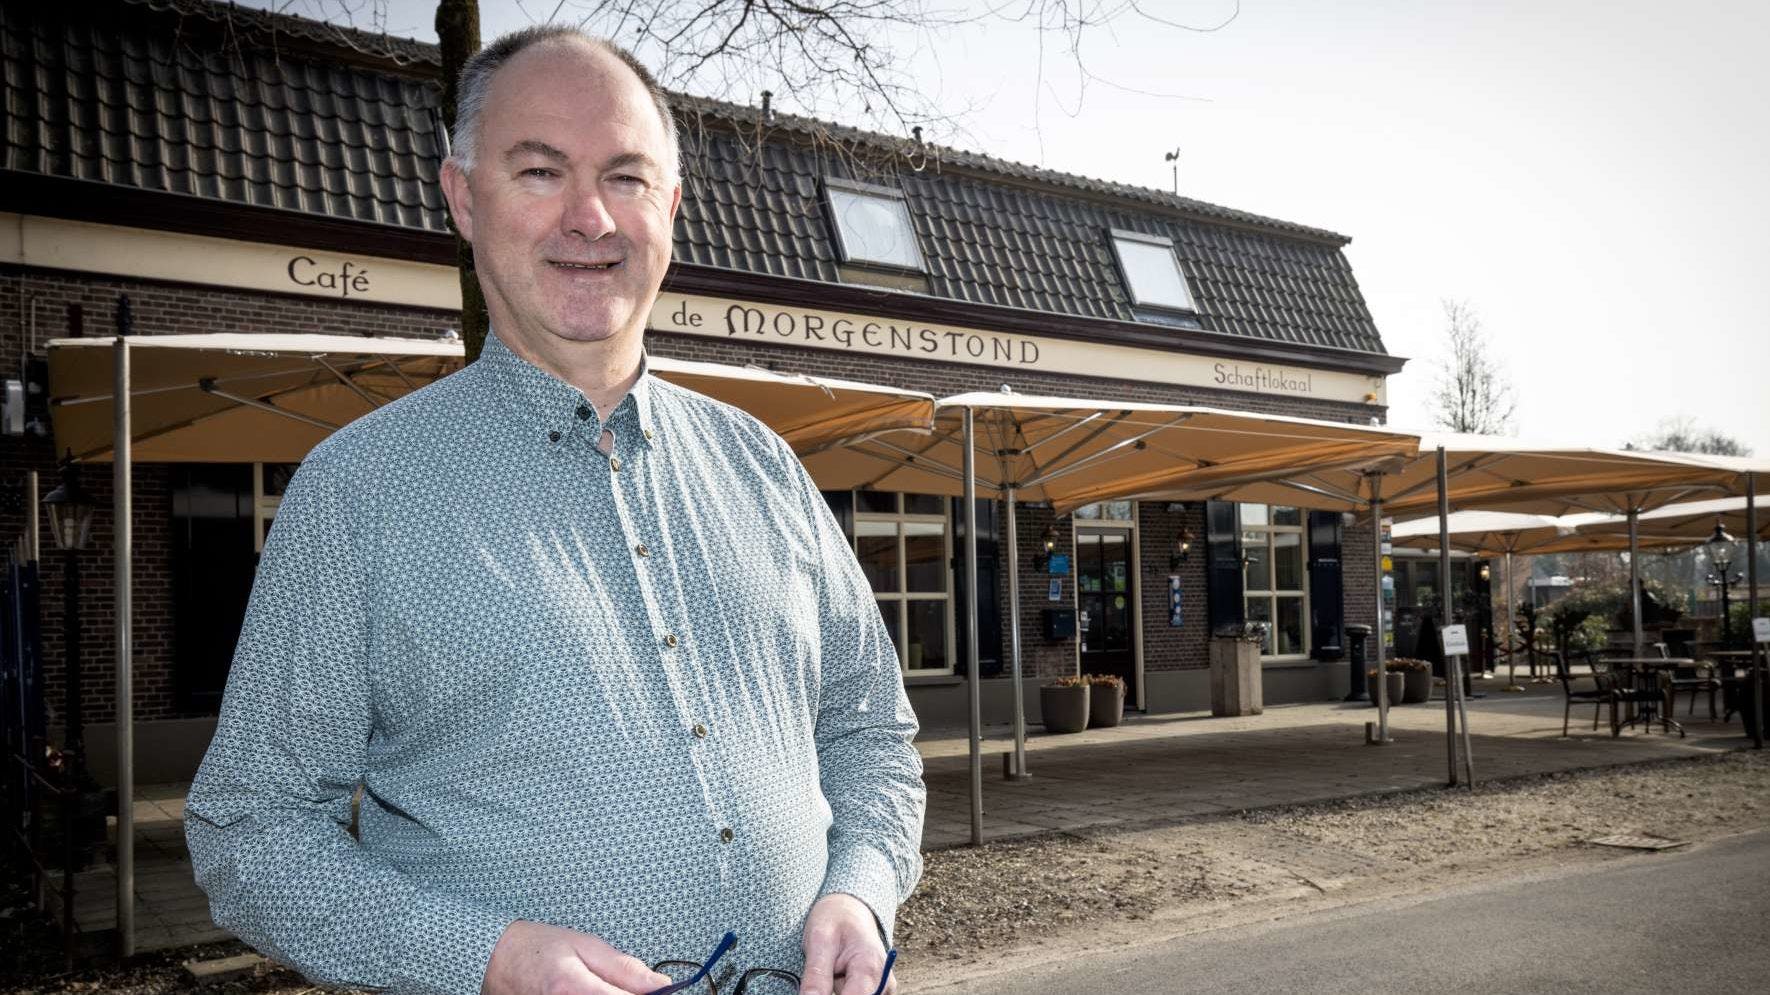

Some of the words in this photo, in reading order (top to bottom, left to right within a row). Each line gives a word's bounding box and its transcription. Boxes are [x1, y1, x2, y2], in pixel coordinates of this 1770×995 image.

[287, 256, 370, 297] Café
[671, 301, 703, 327] de
[724, 304, 1040, 364] MORGENSTOND
[1214, 363, 1312, 392] Schaftlokaal
